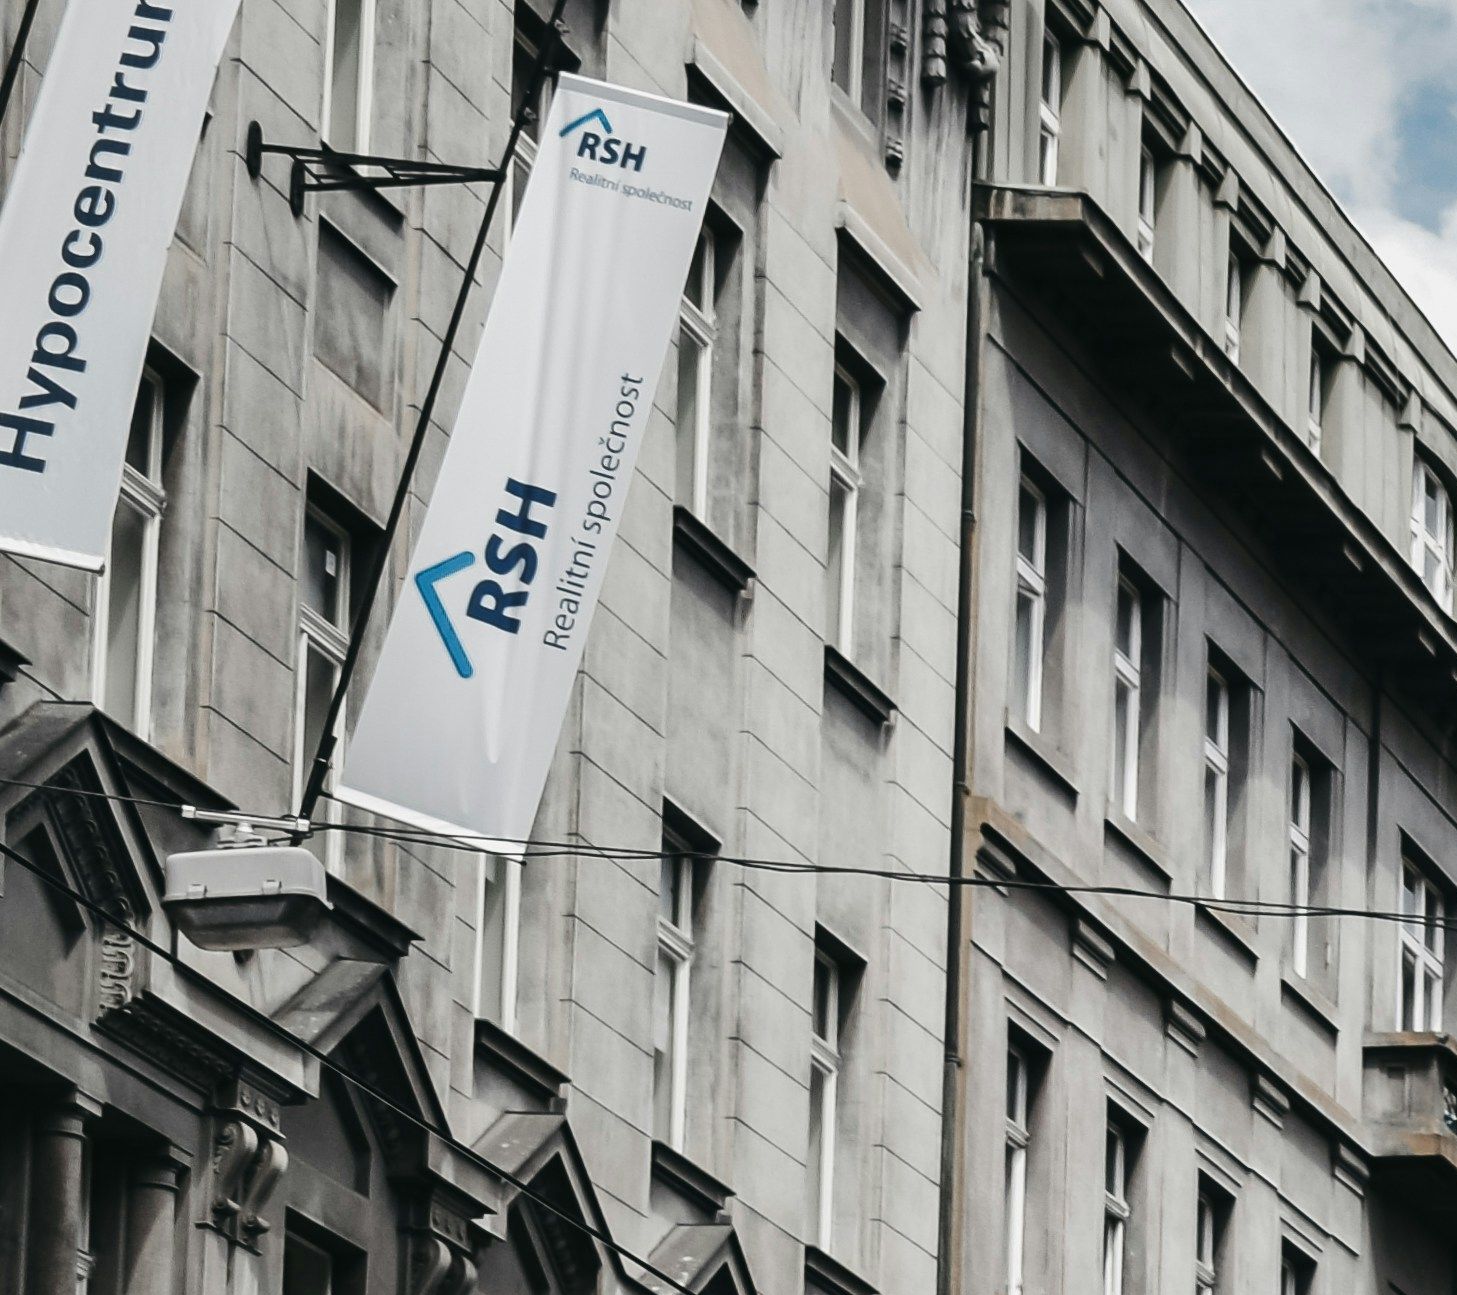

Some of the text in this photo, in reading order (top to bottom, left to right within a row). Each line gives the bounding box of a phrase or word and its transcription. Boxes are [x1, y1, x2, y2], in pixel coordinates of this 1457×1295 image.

[569, 167, 694, 212] Realitní společnost
[576, 131, 648, 173] RSH
[466, 476, 558, 635] RSH
[543, 372, 645, 652] Realitní společnost
